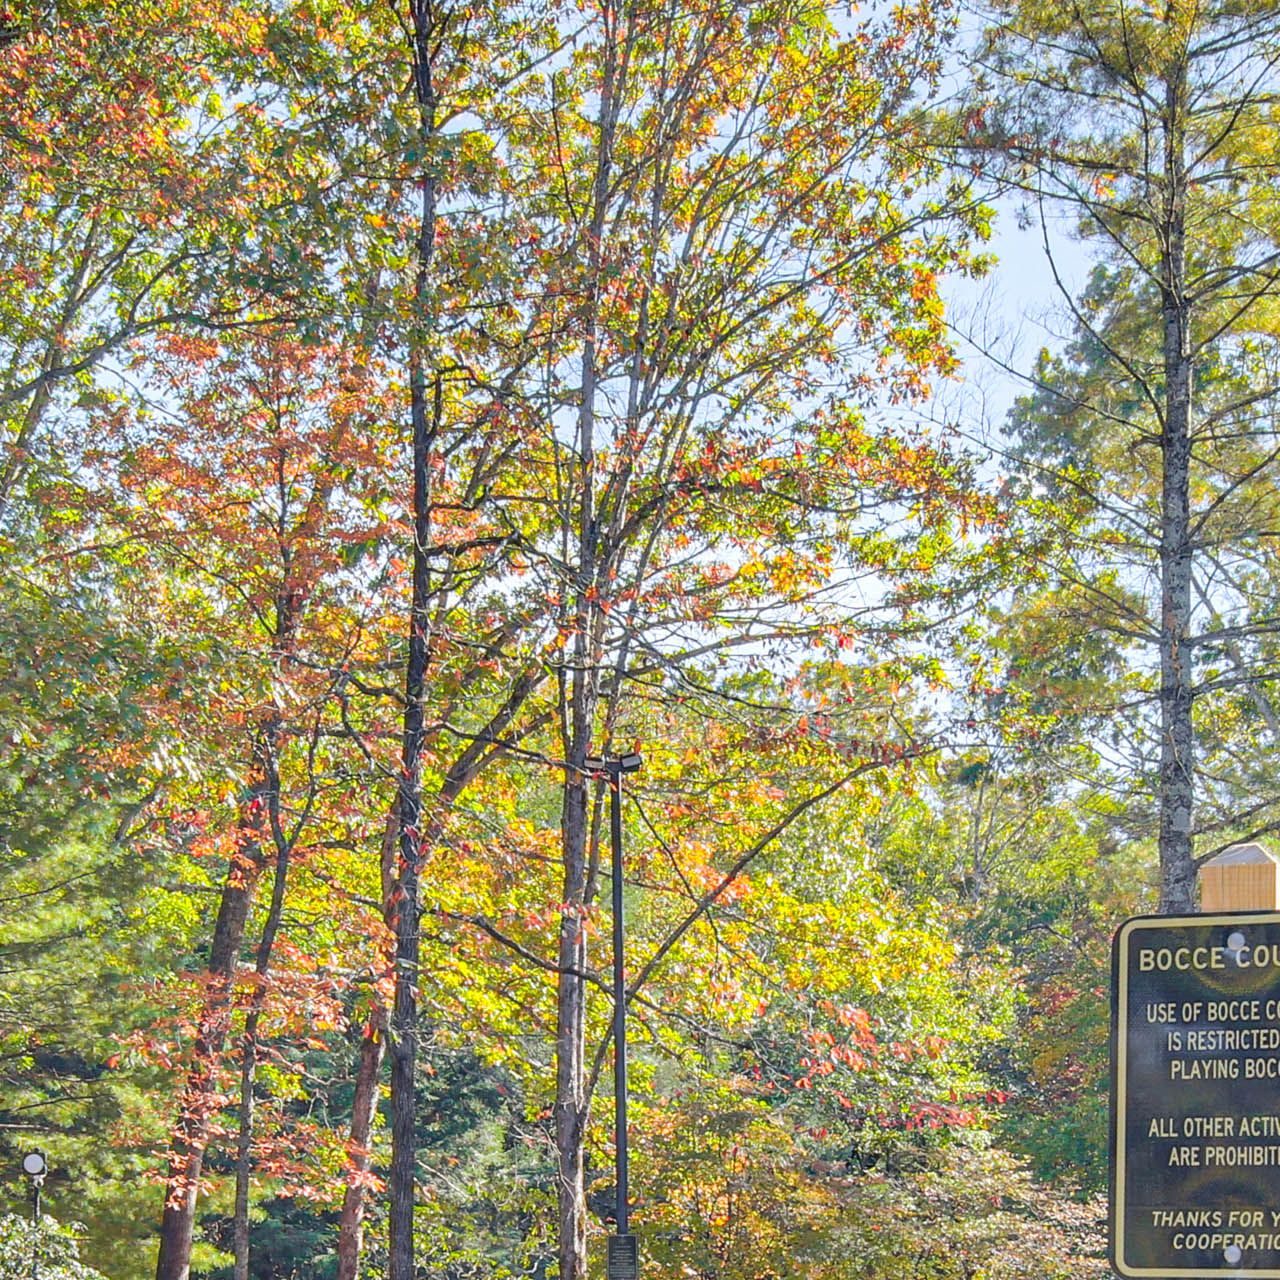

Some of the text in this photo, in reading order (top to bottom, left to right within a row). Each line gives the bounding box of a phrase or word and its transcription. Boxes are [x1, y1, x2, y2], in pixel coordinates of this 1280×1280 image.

[1139, 946, 1225, 971] BOCCE
[1147, 1003, 1177, 1023] USE
[1182, 1002, 1203, 1022] OF
[1208, 1000, 1261, 1021] BOCCE
[1168, 1031, 1182, 1051] IS
[1187, 1029, 1280, 1051] RESTRICTED
[1171, 1059, 1239, 1080] PLAYING
[1148, 1118, 1179, 1138] ALL
[1183, 1117, 1235, 1137] OTHER
[1168, 1147, 1200, 1167] ARE
[1152, 1211, 1223, 1228] THANKS
[1228, 1211, 1264, 1228] FOR
